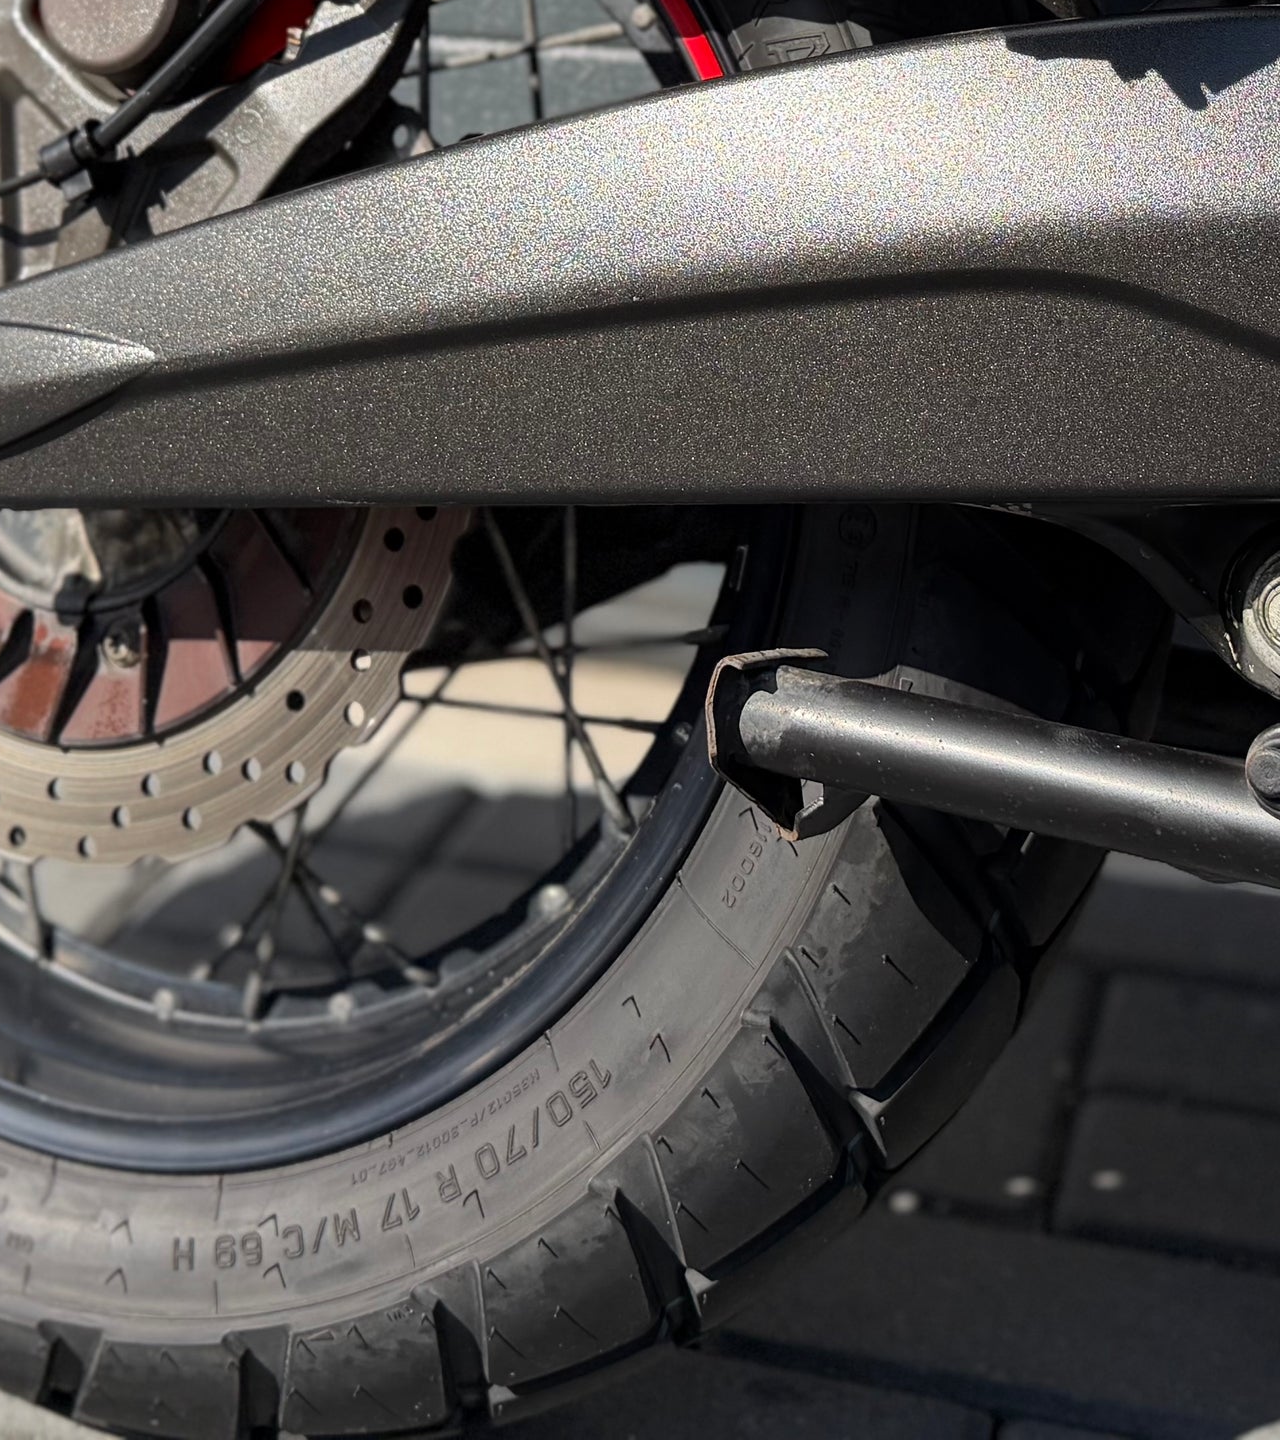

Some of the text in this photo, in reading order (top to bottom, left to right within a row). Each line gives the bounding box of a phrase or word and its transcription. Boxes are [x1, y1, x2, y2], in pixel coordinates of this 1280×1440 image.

[172, 1058, 612, 1272] 150/70 R 17 M/C 69 H
